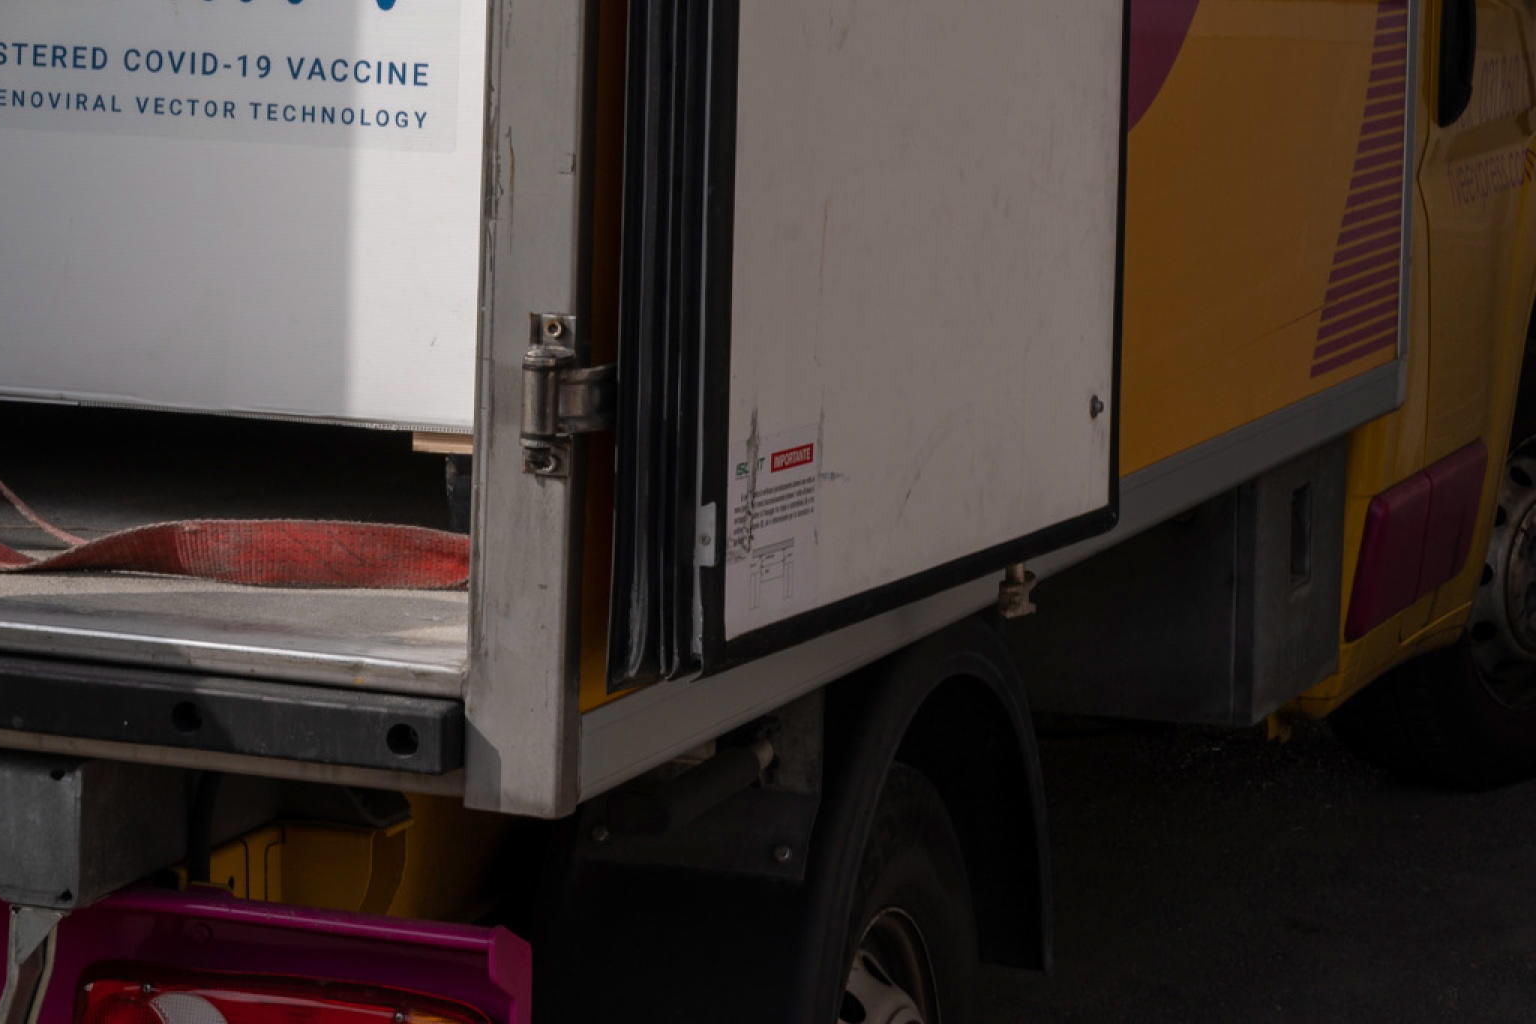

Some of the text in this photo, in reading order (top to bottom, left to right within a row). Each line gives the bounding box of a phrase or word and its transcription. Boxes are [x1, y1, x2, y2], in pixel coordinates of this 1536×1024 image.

[124, 49, 270, 78] COVID-19
[288, 58, 428, 86] VACCINE
[136, 98, 235, 118] VECTOR
[250, 103, 426, 128] TECHNOLOGY
